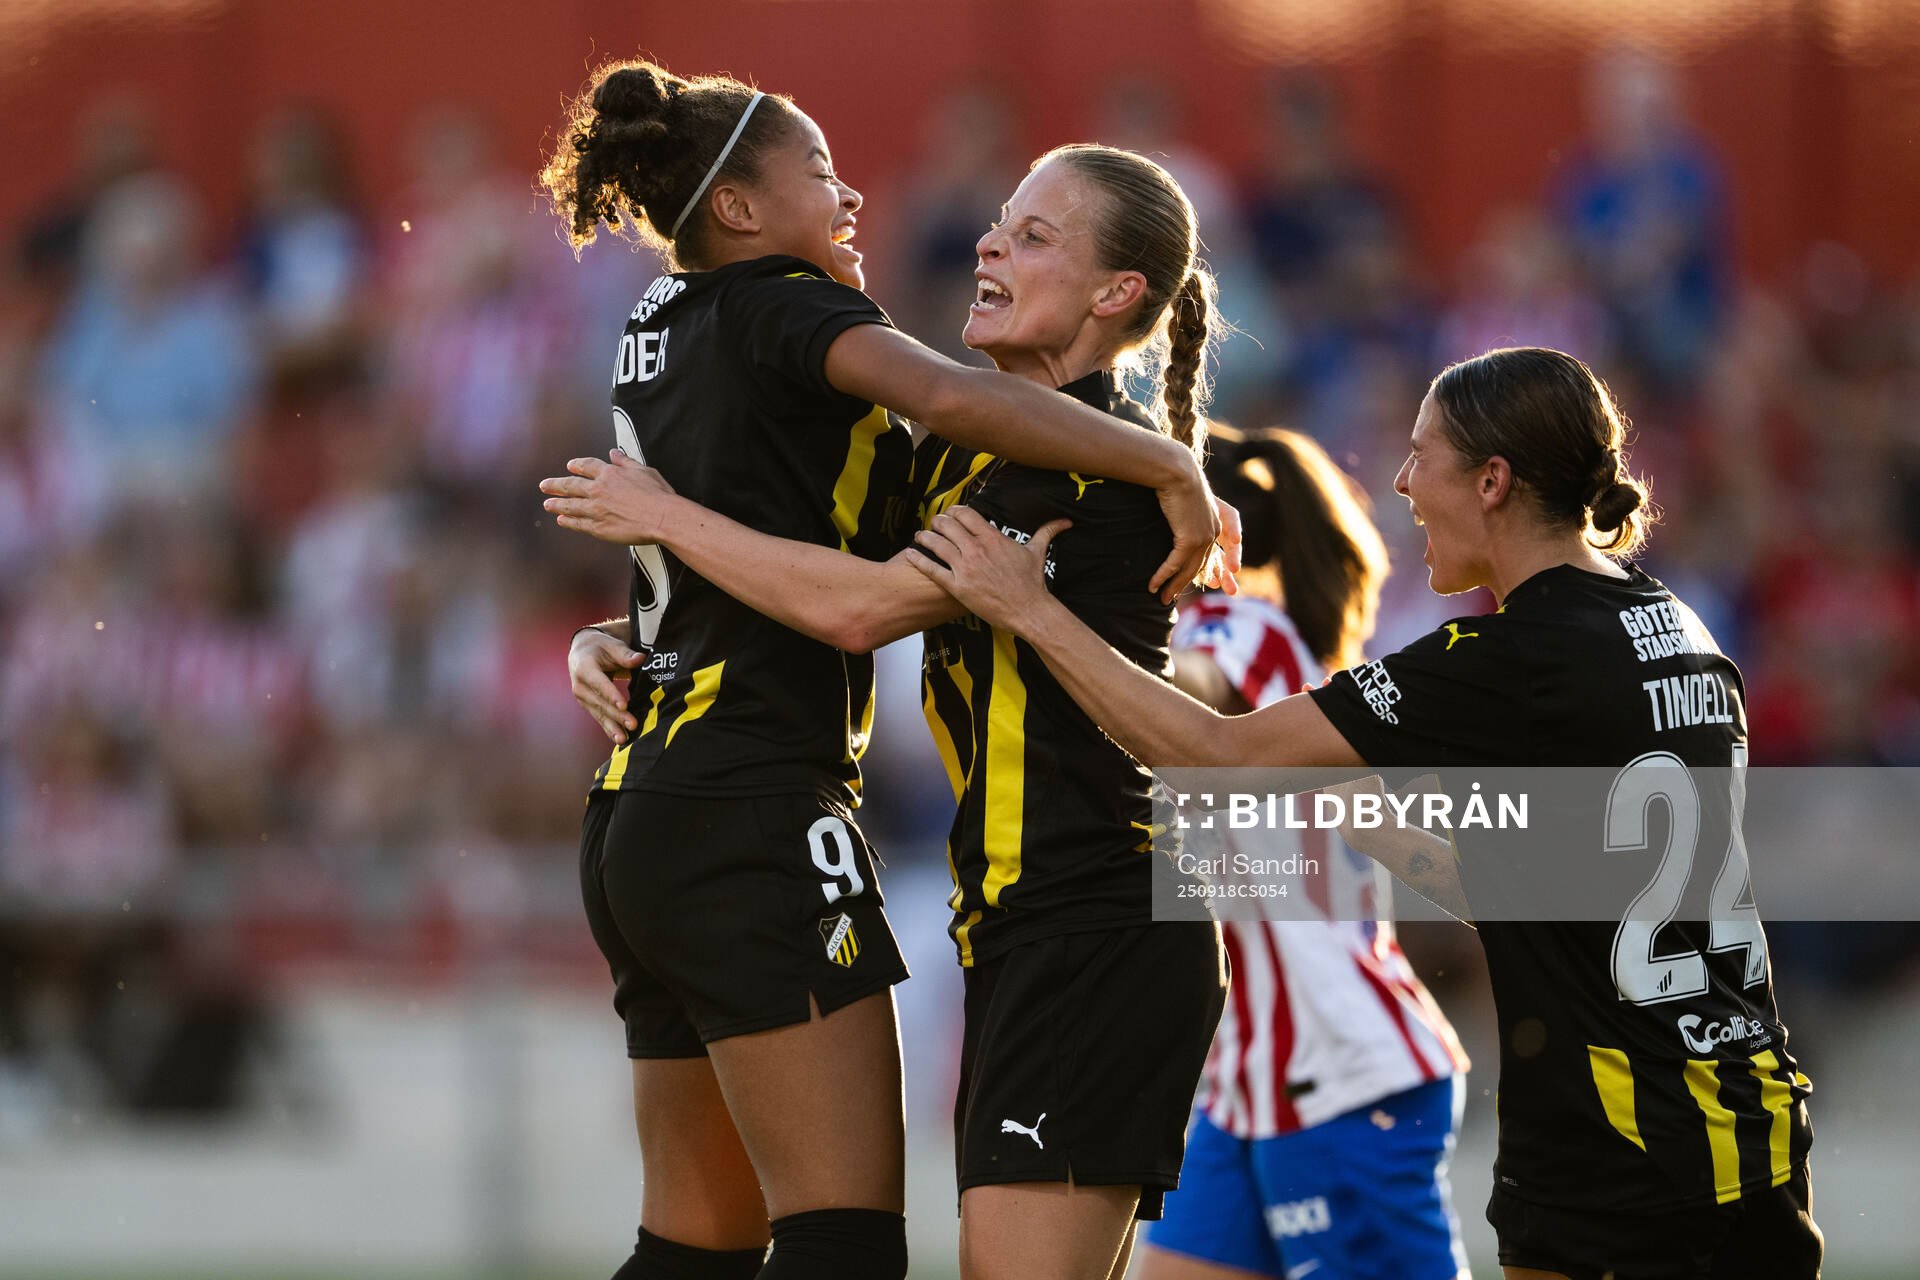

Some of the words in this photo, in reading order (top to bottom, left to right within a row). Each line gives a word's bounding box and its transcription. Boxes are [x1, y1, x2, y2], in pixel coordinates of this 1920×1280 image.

[1642, 673, 1734, 732] TINDELL
[806, 816, 864, 905] 9
[1604, 742, 1768, 1006] 24
